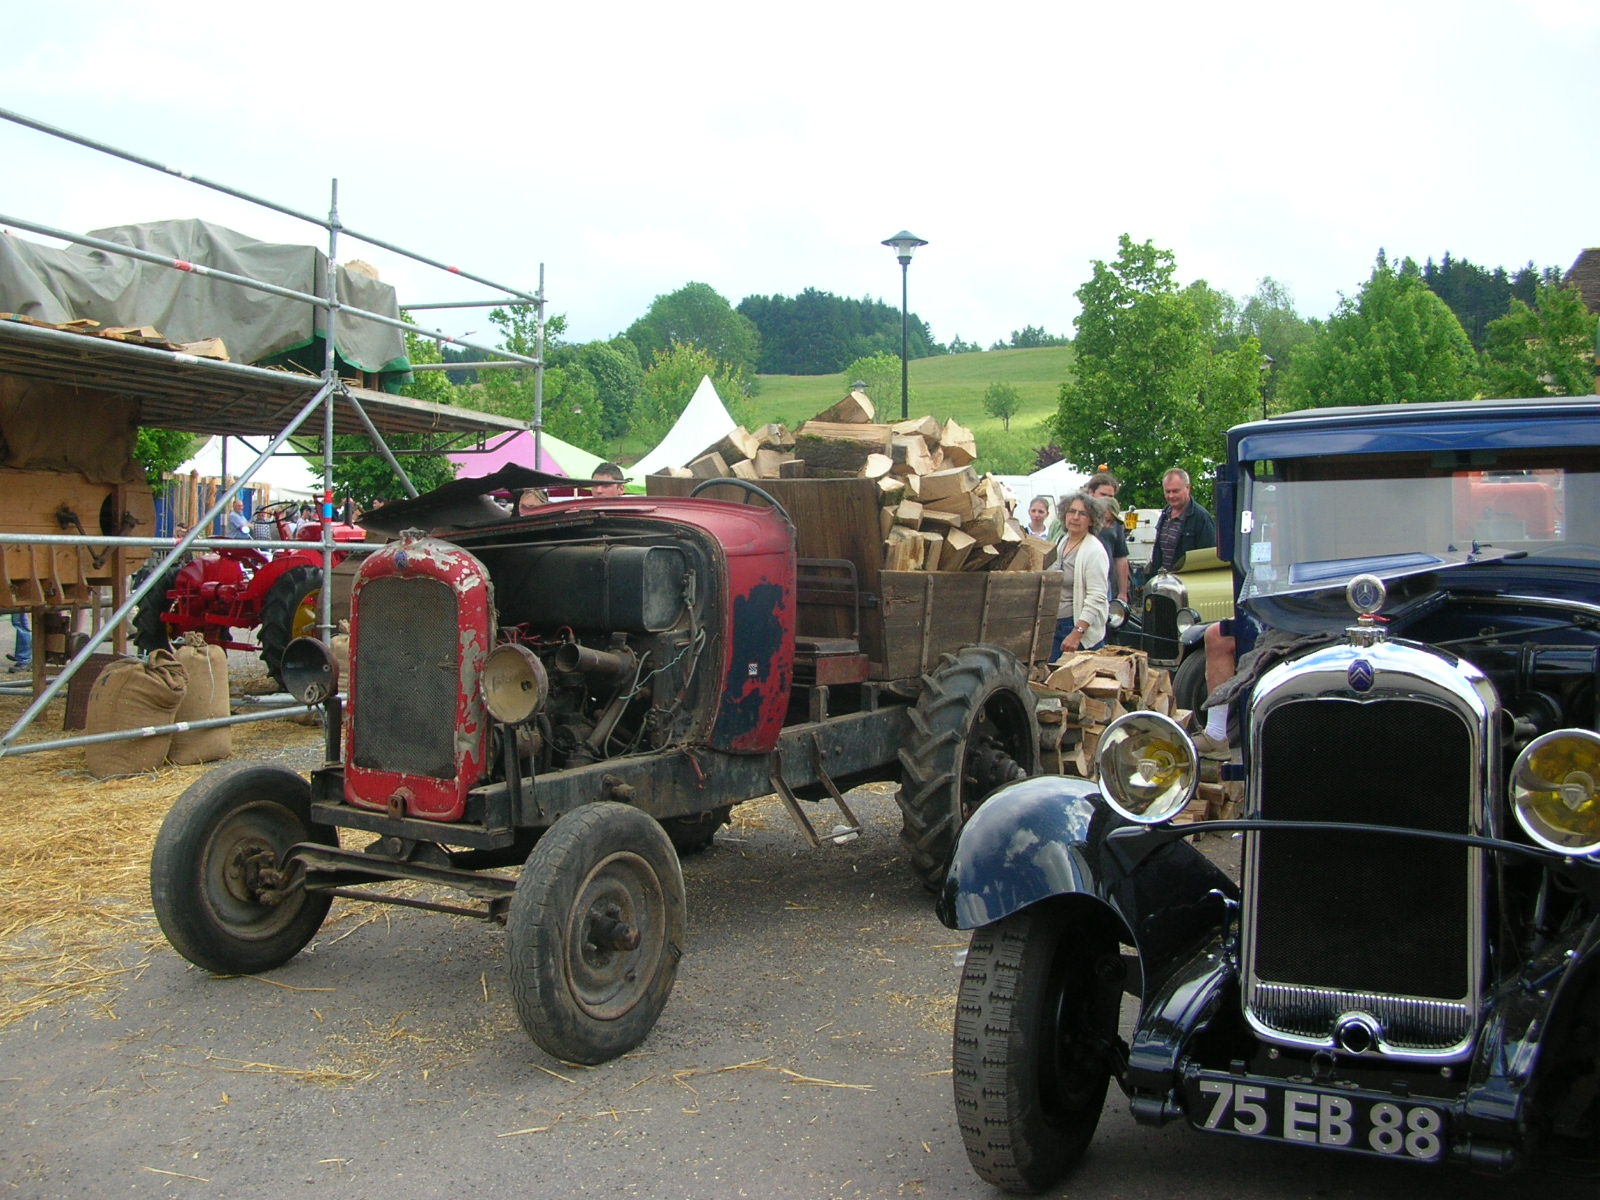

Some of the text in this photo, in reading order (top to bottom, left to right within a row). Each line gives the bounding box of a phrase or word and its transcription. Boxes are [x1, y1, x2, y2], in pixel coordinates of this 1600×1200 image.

[1200, 1081, 1440, 1159] 75 EB 88
